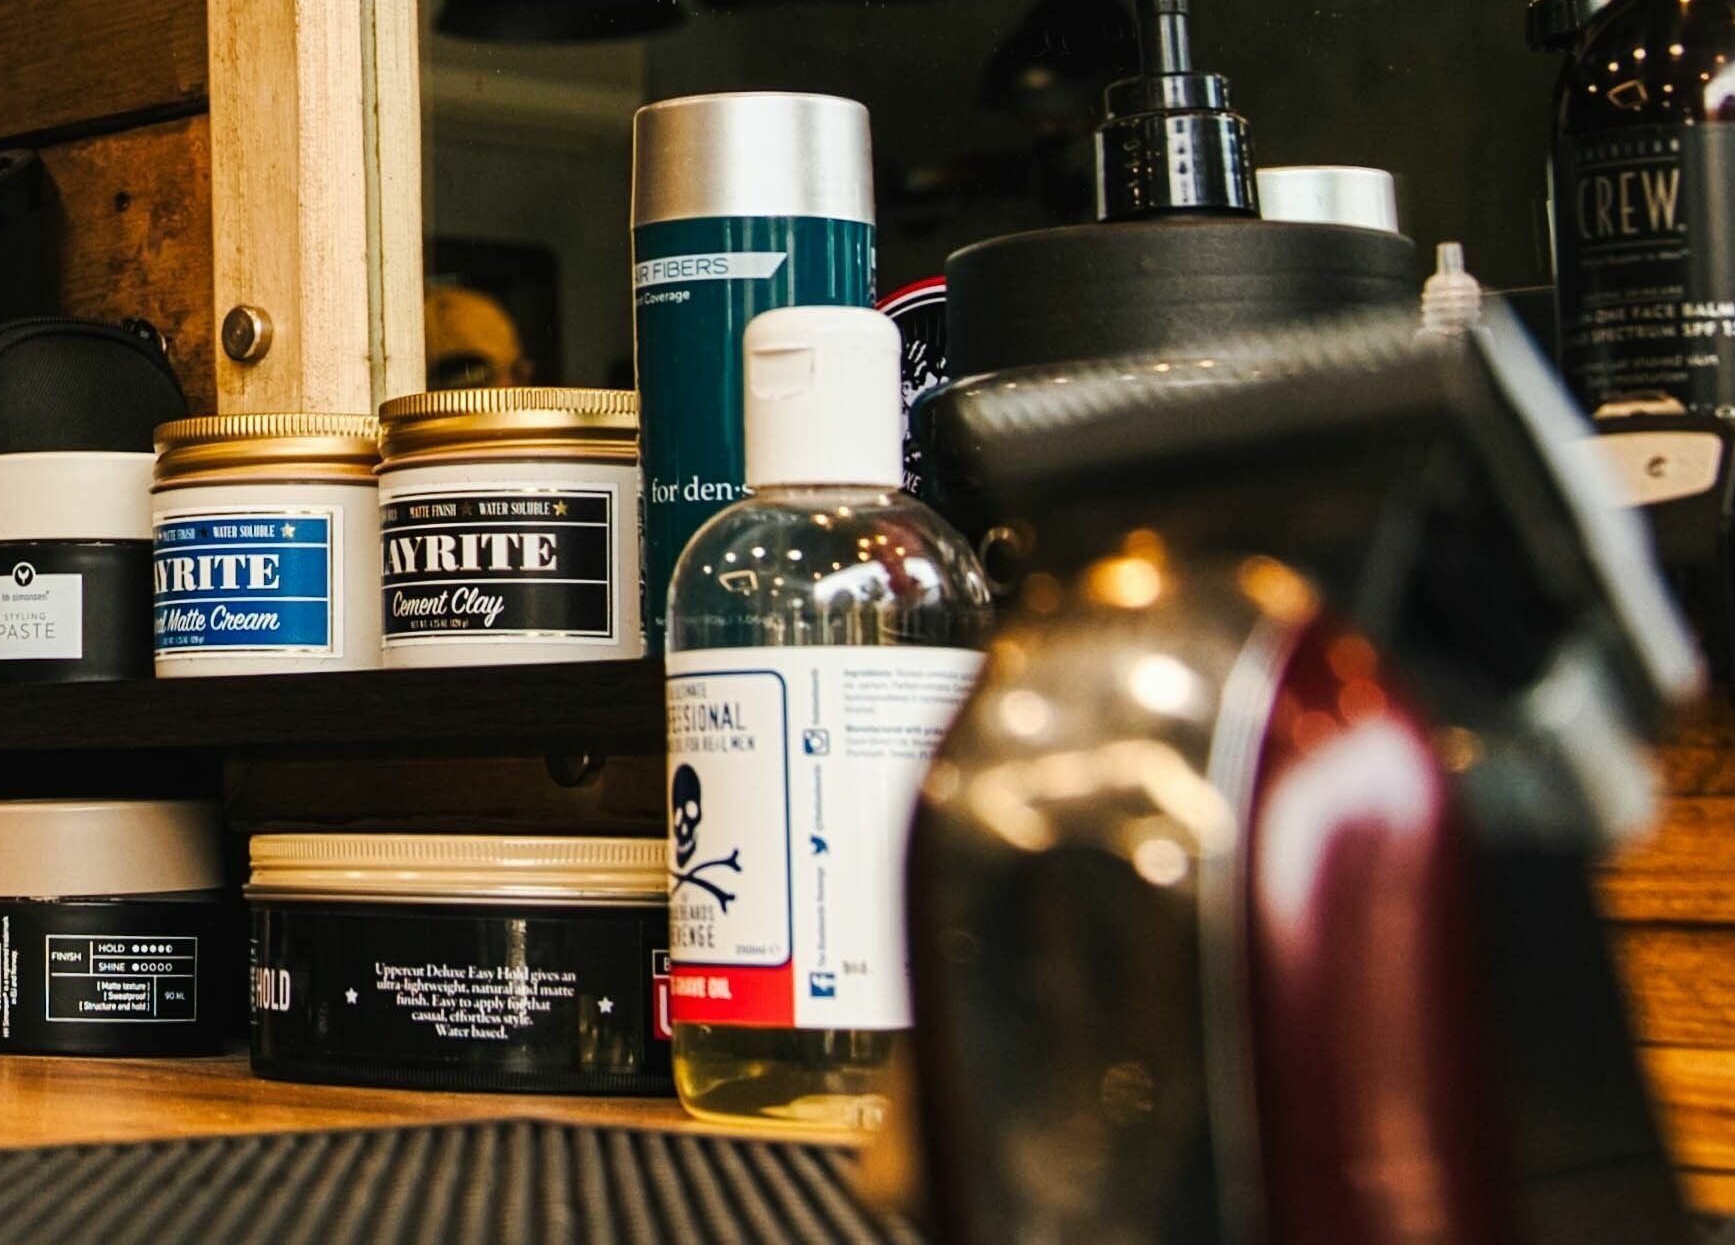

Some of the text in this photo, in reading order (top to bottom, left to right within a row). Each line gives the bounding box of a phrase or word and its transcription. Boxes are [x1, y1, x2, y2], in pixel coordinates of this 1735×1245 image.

[1576, 168, 1681, 240] CREW
[652, 257, 729, 281] FIBERS
[644, 289, 691, 305] Coverage
[651, 477, 678, 503] for
[431, 503, 457, 517] FINISH
[478, 502, 509, 516] WATER
[510, 501, 551, 515] SOLUBLE
[212, 526, 238, 539] WATER
[239, 524, 276, 538] SOLUBLE
[393, 587, 505, 628] Cement Clay
[3, 612, 47, 621] STYLING
[168, 604, 281, 632] Matte Cream
[51, 949, 82, 962] FINISH
[98, 944, 125, 954] HOLD
[98, 962, 126, 972] SHINE
[375, 962, 576, 984] Uppercut Deluxe Easy Hold gives an
[101, 981, 122, 991] Matte
[471, 980, 513, 995] natural
[540, 985, 575, 997] matte
[164, 991, 175, 1001] 90
[396, 992, 429, 1006] finish.
[431, 993, 457, 1011] Easy
[459, 996, 472, 1008] to
[472, 996, 505, 1013] apply
[84, 1001, 146, 1012] Structure and hold
[411, 1008, 534, 1028] casual, effortless style.
[435, 1023, 509, 1040] Water based.
